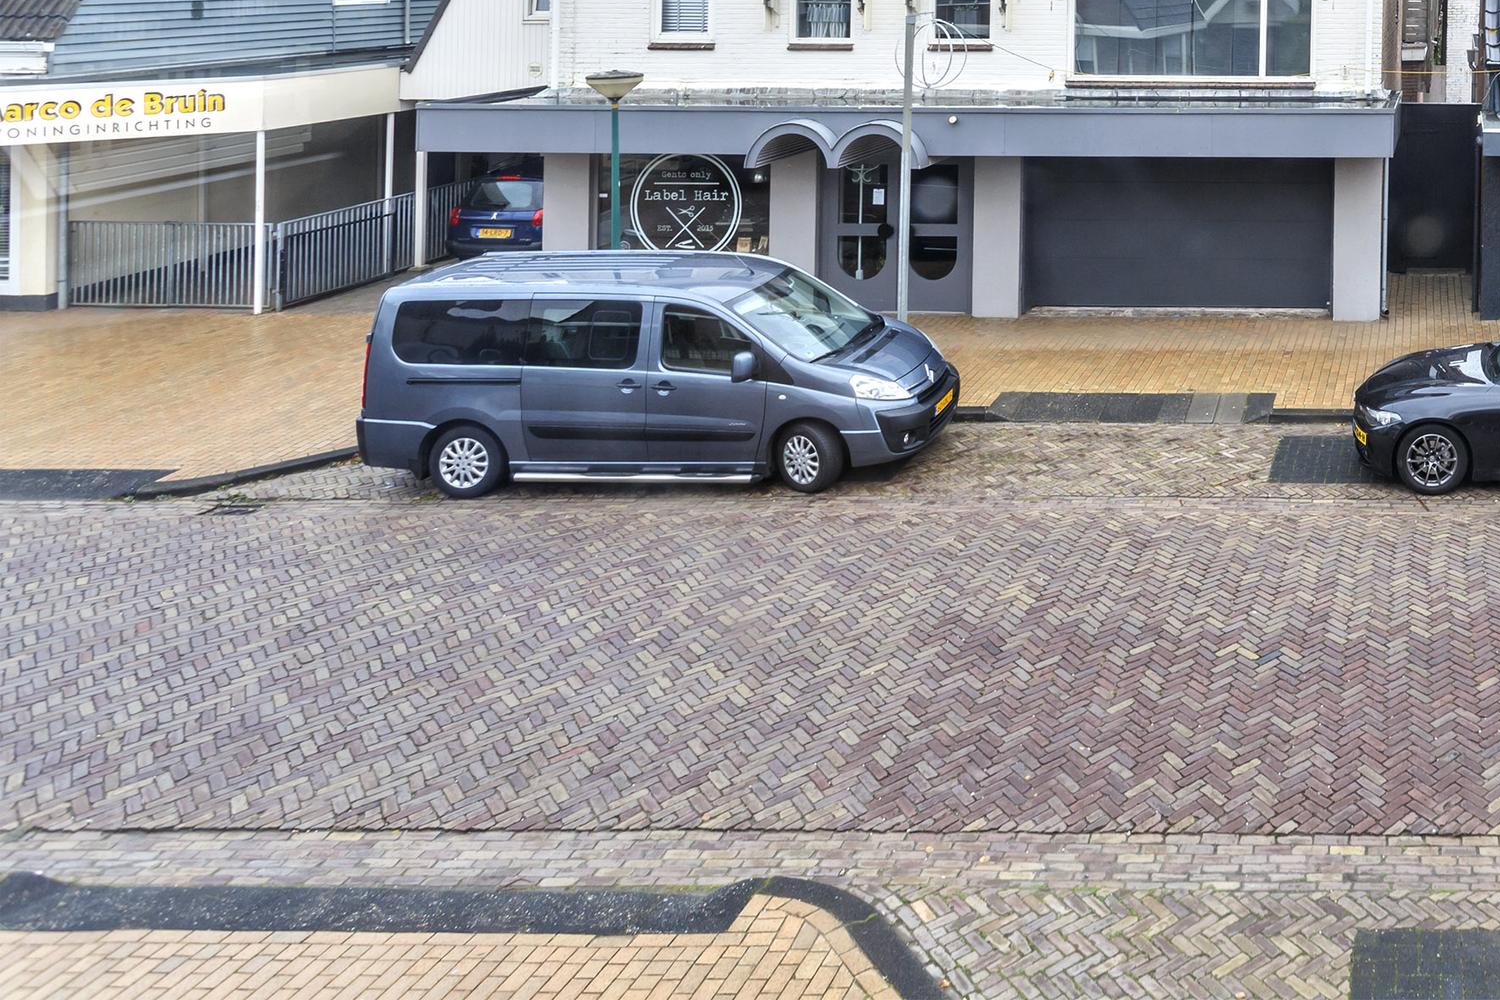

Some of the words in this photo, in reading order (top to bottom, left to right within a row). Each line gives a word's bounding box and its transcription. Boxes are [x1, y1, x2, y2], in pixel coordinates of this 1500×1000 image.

[0, 100, 82, 123] arco
[90, 94, 136, 118] de
[143, 88, 226, 115] Bruin
[0, 117, 213, 139] ONINGINRICHTING
[690, 170, 712, 180] only
[644, 189, 687, 201] Label
[694, 189, 729, 201] Hair
[696, 224, 714, 232] 2015
